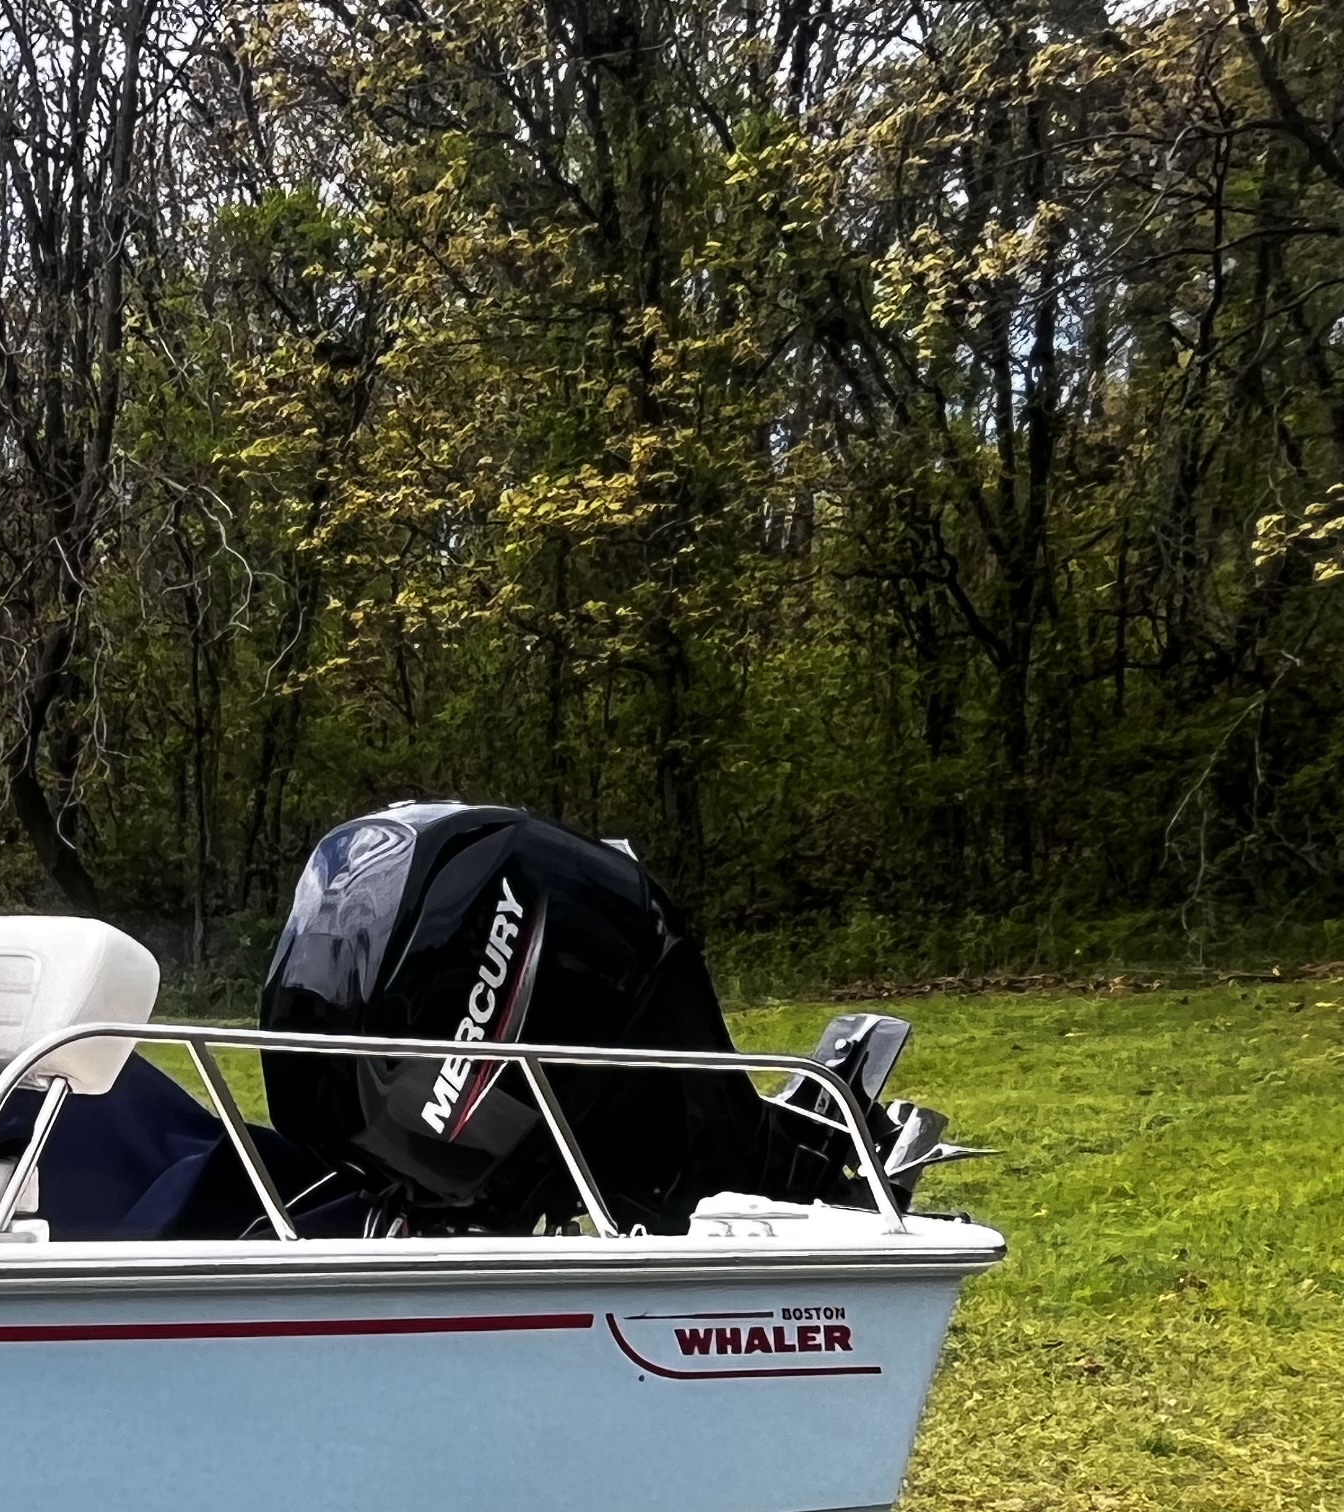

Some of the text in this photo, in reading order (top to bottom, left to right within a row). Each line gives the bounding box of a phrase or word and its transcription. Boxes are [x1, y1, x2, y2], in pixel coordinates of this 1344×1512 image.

[421, 877, 523, 1134] MERCURY
[781, 1307, 846, 1321] BOSTON
[674, 1325, 853, 1355] WHALER
